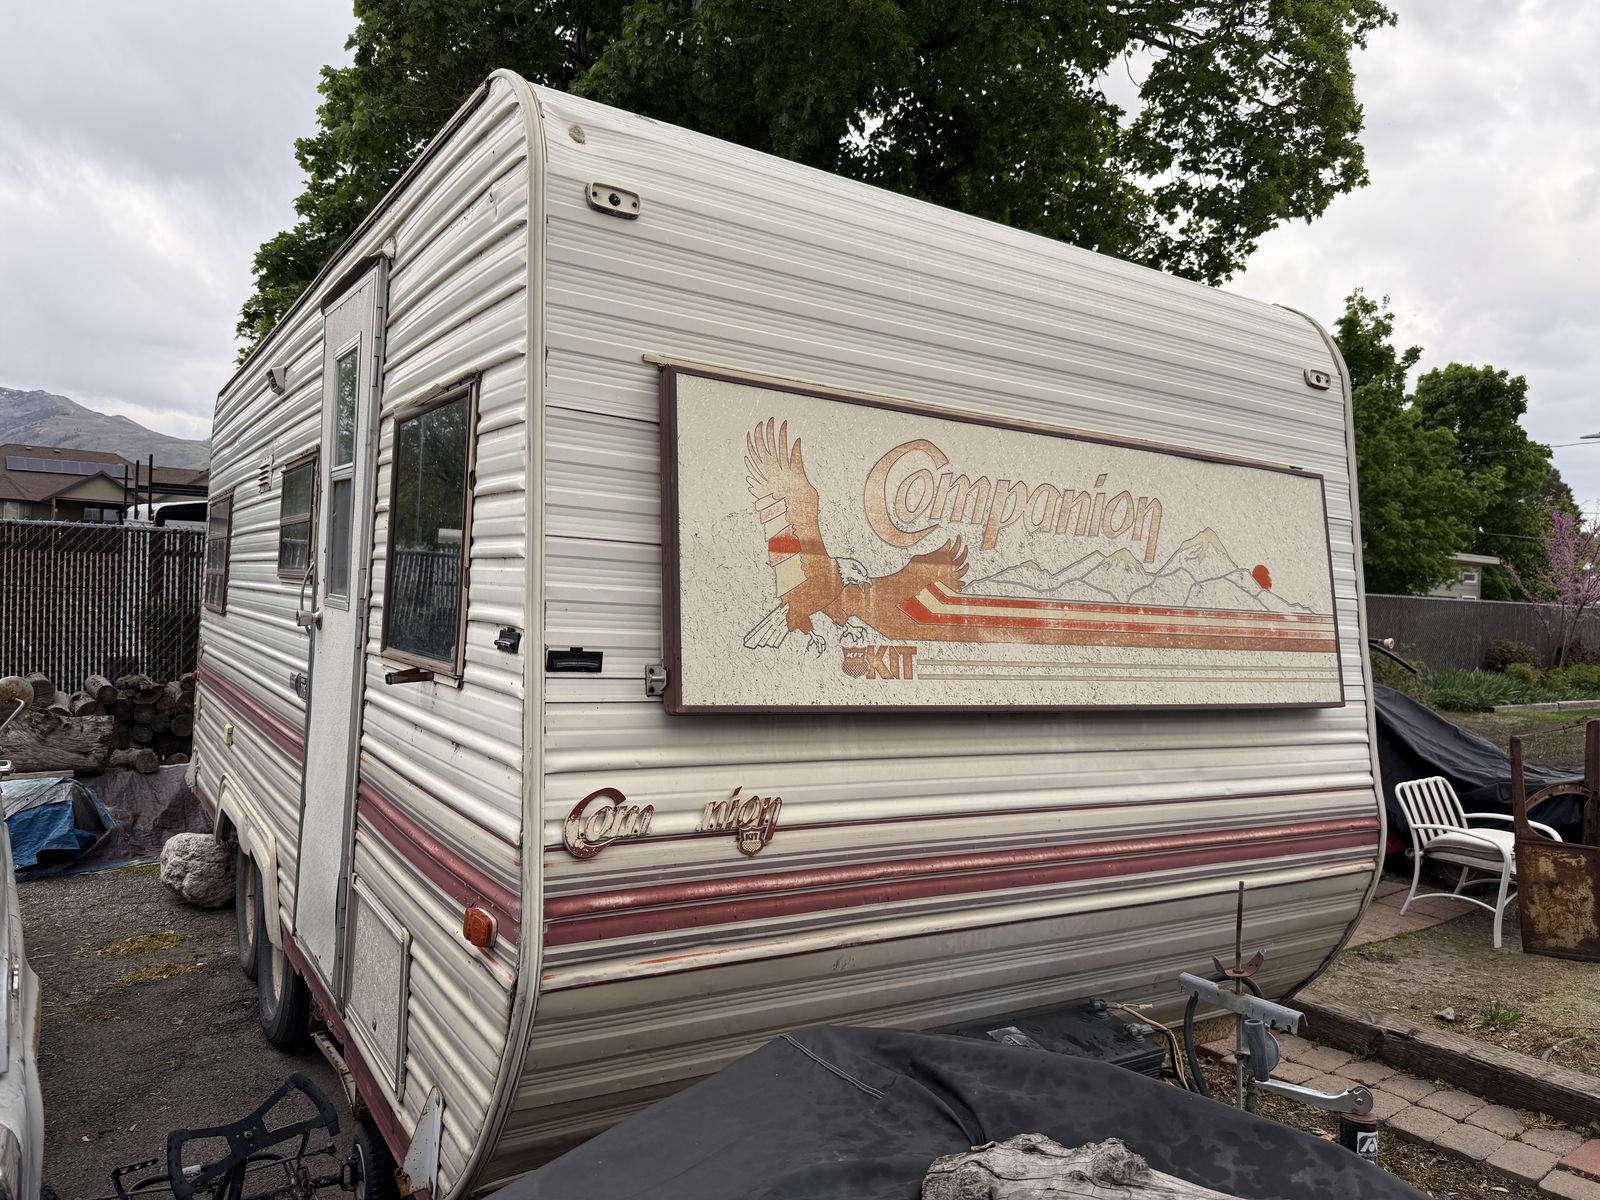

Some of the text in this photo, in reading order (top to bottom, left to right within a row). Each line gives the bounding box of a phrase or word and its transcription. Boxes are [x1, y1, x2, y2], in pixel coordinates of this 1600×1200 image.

[864, 438, 1163, 564] Companion
[866, 645, 917, 679] KIT
[564, 787, 654, 858] Com
[745, 832, 758, 841] KIT
